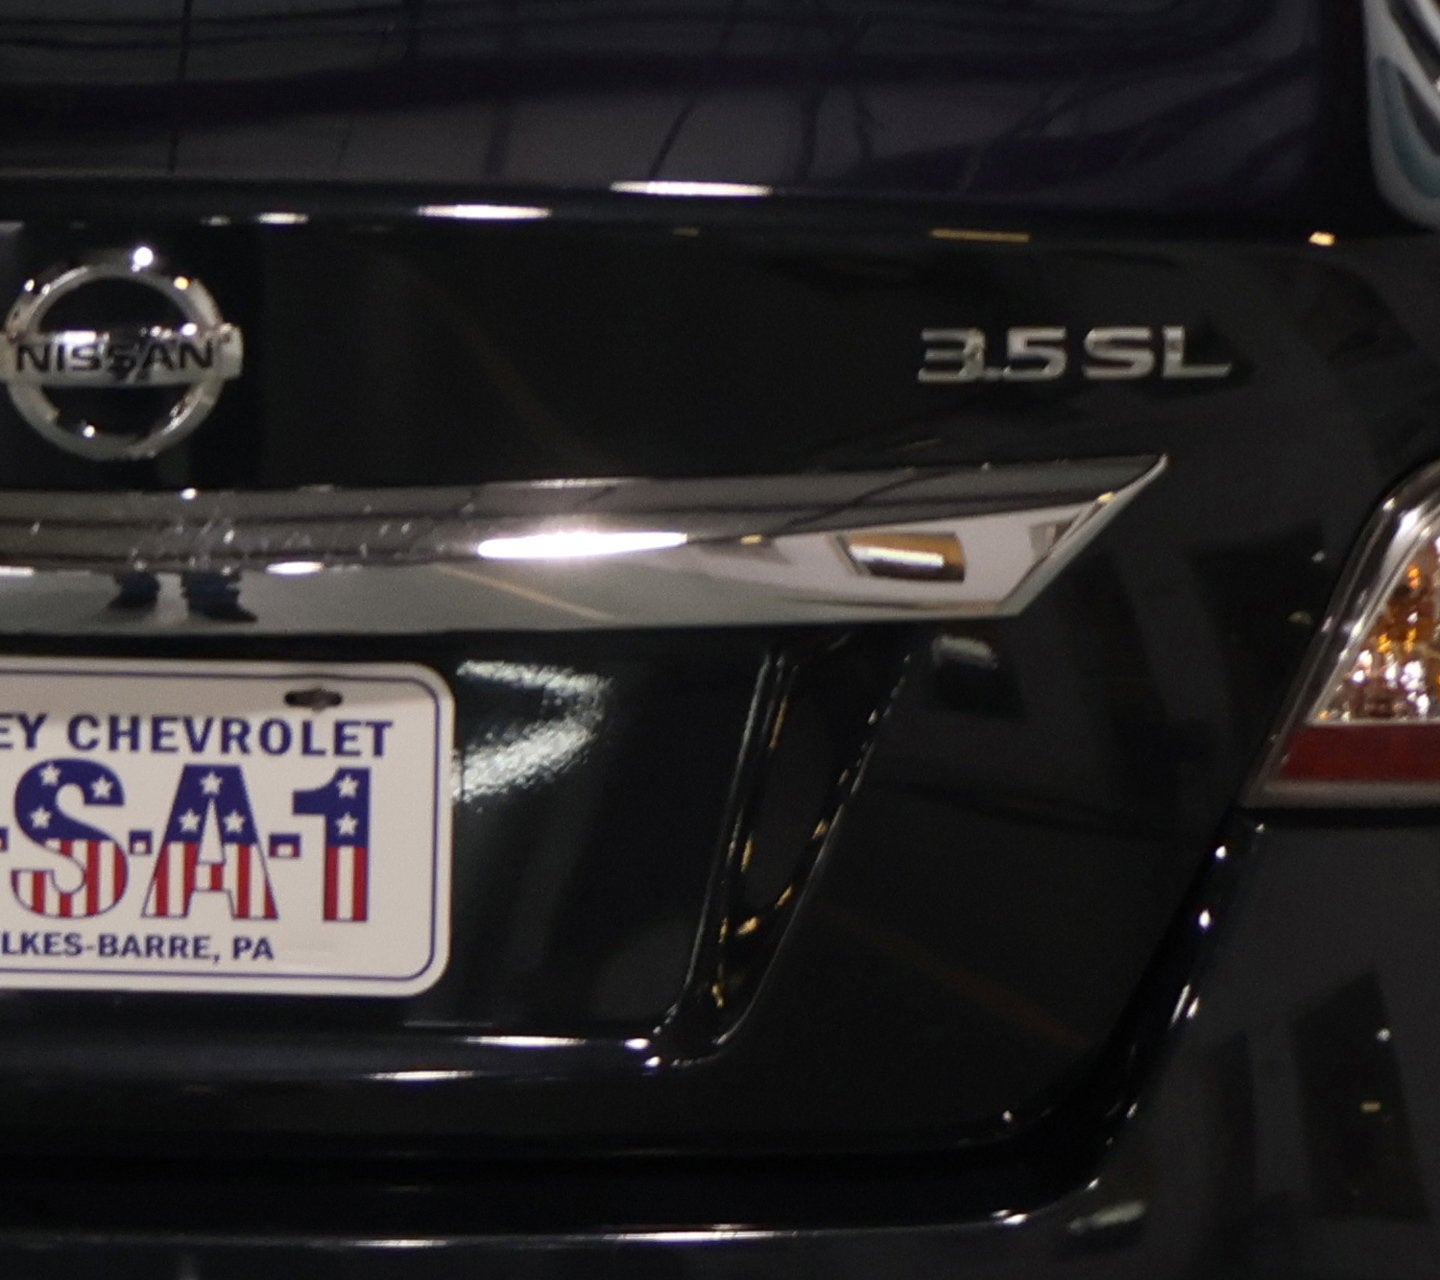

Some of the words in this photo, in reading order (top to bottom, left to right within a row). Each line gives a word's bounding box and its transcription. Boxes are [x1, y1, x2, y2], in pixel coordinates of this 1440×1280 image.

[16, 335, 215, 373] NISSAN
[67, 713, 394, 758] CHEVROLET
[232, 936, 275, 961] PA
